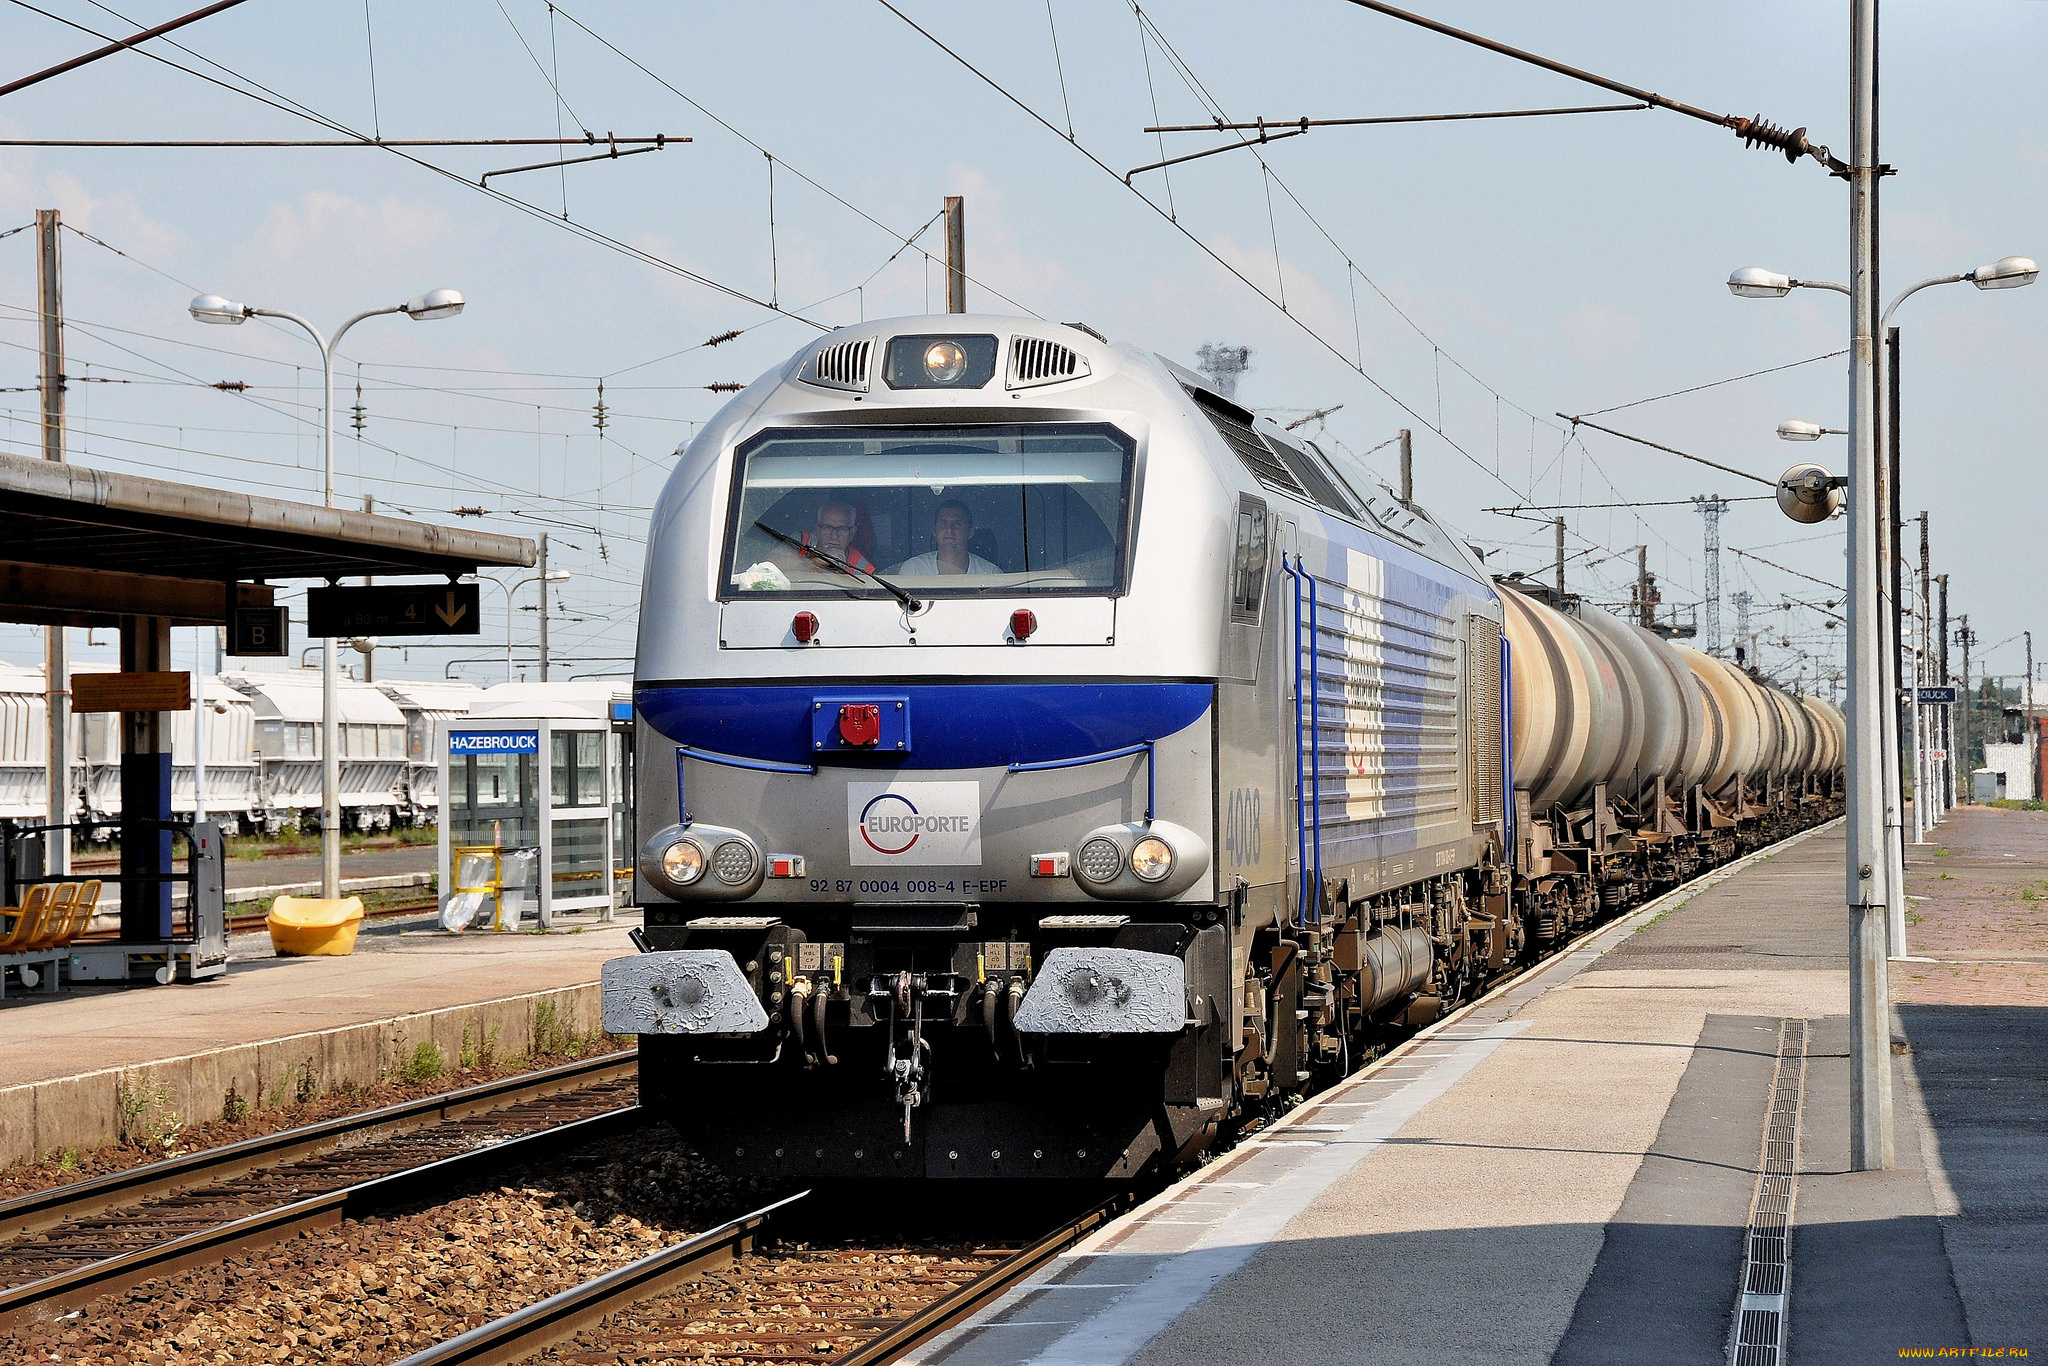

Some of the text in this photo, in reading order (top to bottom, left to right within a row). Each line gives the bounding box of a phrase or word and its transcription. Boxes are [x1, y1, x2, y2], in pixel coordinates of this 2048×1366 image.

[404, 603, 417, 621] 4
[251, 626, 266, 645] B
[449, 735, 537, 749] HAZEBROUCK
[868, 816, 969, 832] EUROPORTE
[1226, 788, 1260, 867] 4008
[810, 879, 1008, 895] 92 87 0004 008-4 F-EPF
